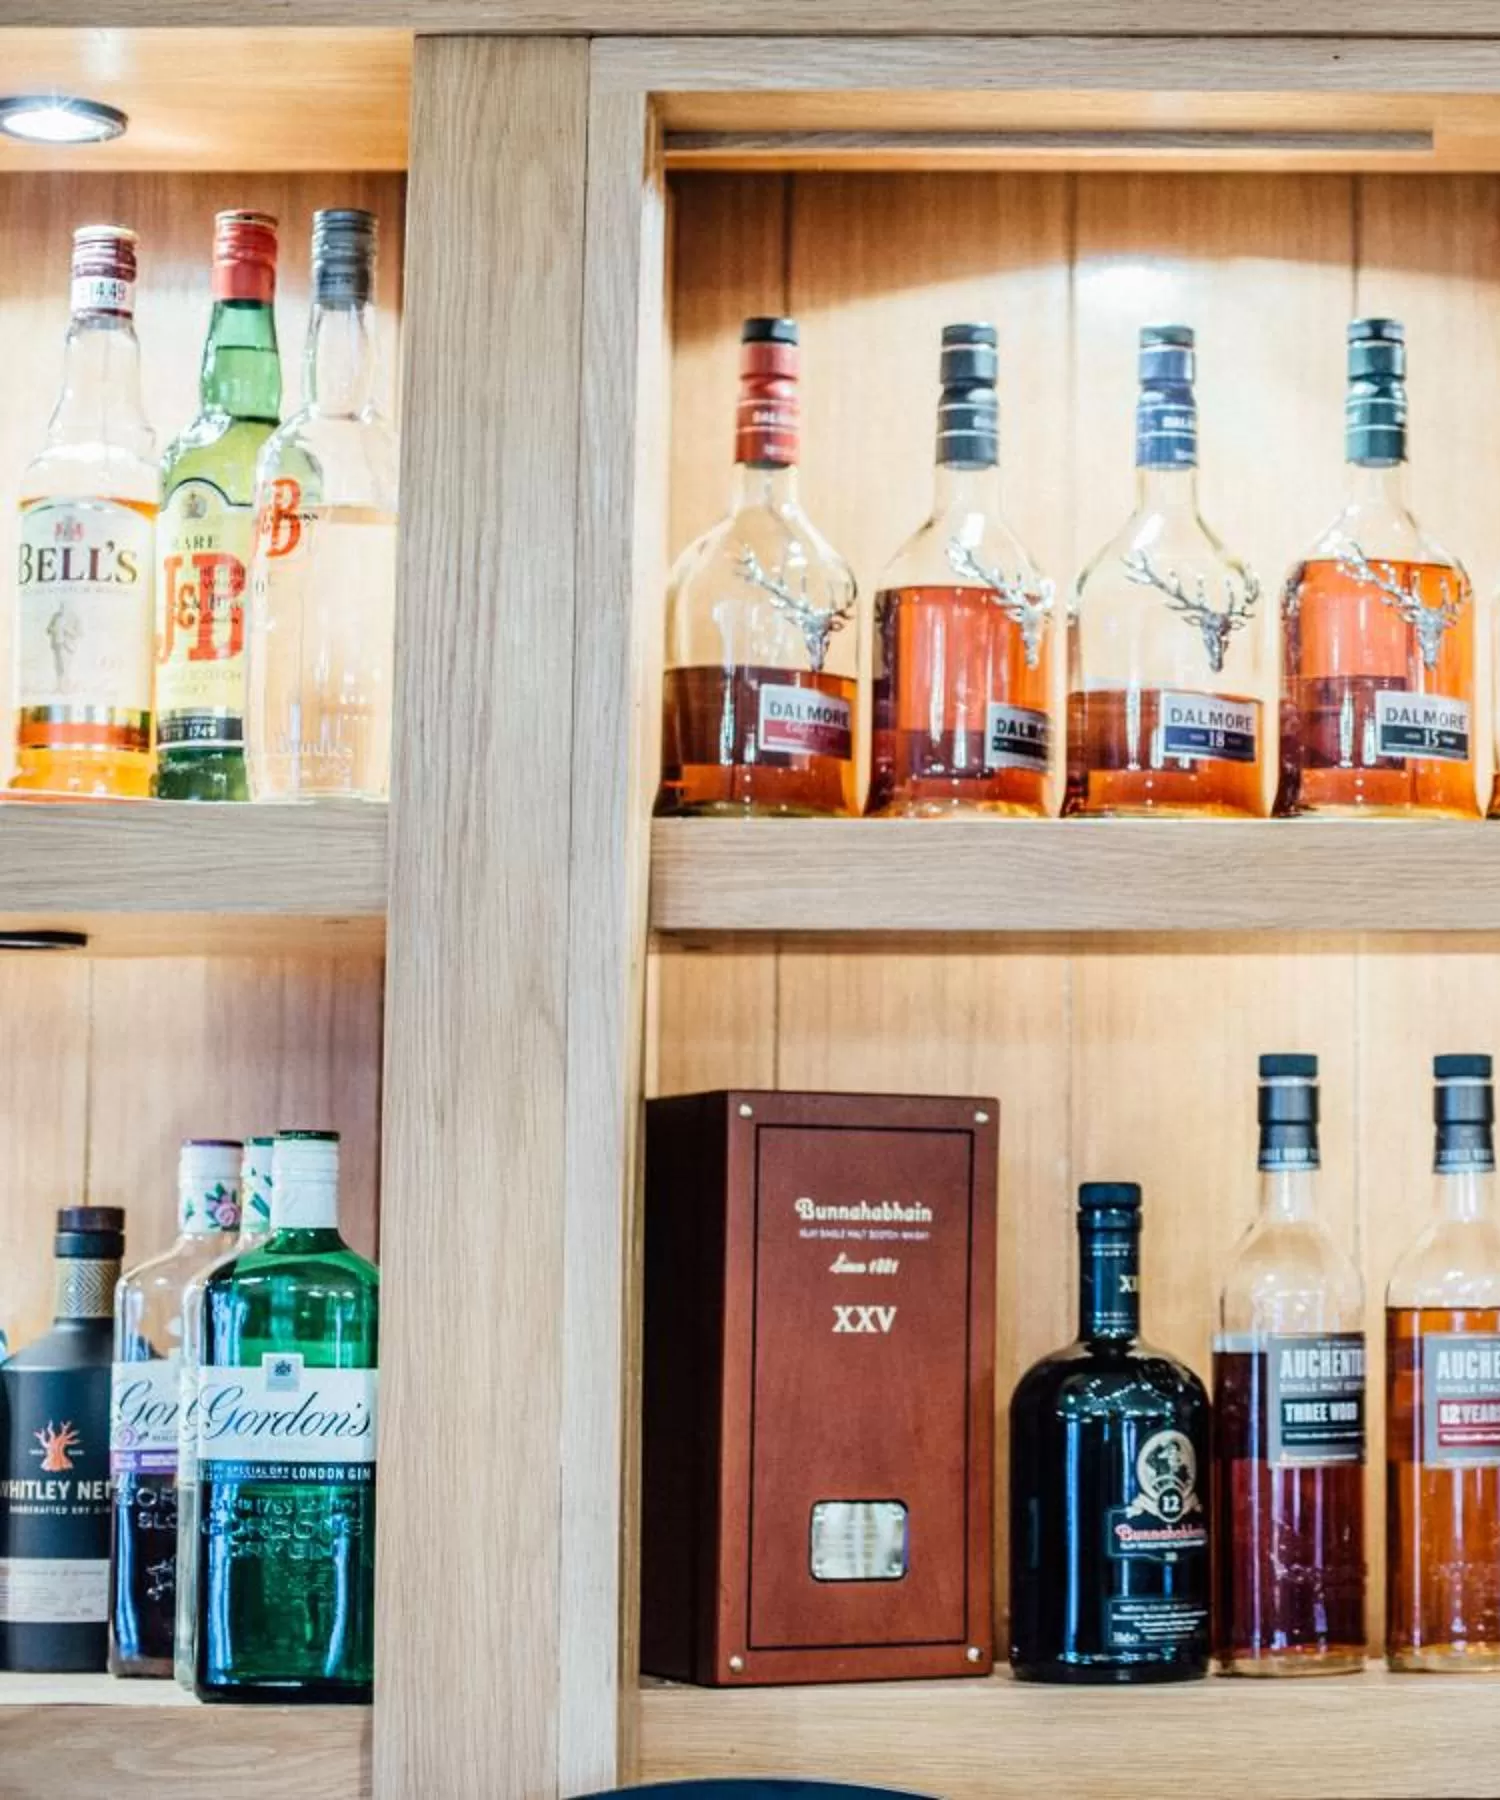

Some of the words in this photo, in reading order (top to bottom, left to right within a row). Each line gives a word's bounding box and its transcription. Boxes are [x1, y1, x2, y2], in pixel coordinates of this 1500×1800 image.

[17, 540, 138, 585] BELL'S
[769, 700, 849, 729] DALMORE
[1170, 707, 1253, 733] DALMORE
[1385, 707, 1467, 731] DALMORE
[1209, 731, 1225, 748] 18
[1424, 728, 1439, 748] 15
[795, 1198, 933, 1222] Bunnahabhain
[832, 1305, 897, 1333] XXV
[200, 1384, 372, 1441] Gordon's
[291, 1467, 345, 1480] LONDON
[347, 1466, 372, 1480] GIN
[0, 1480, 71, 1501] WHITLEY
[1161, 1495, 1181, 1512] 12
